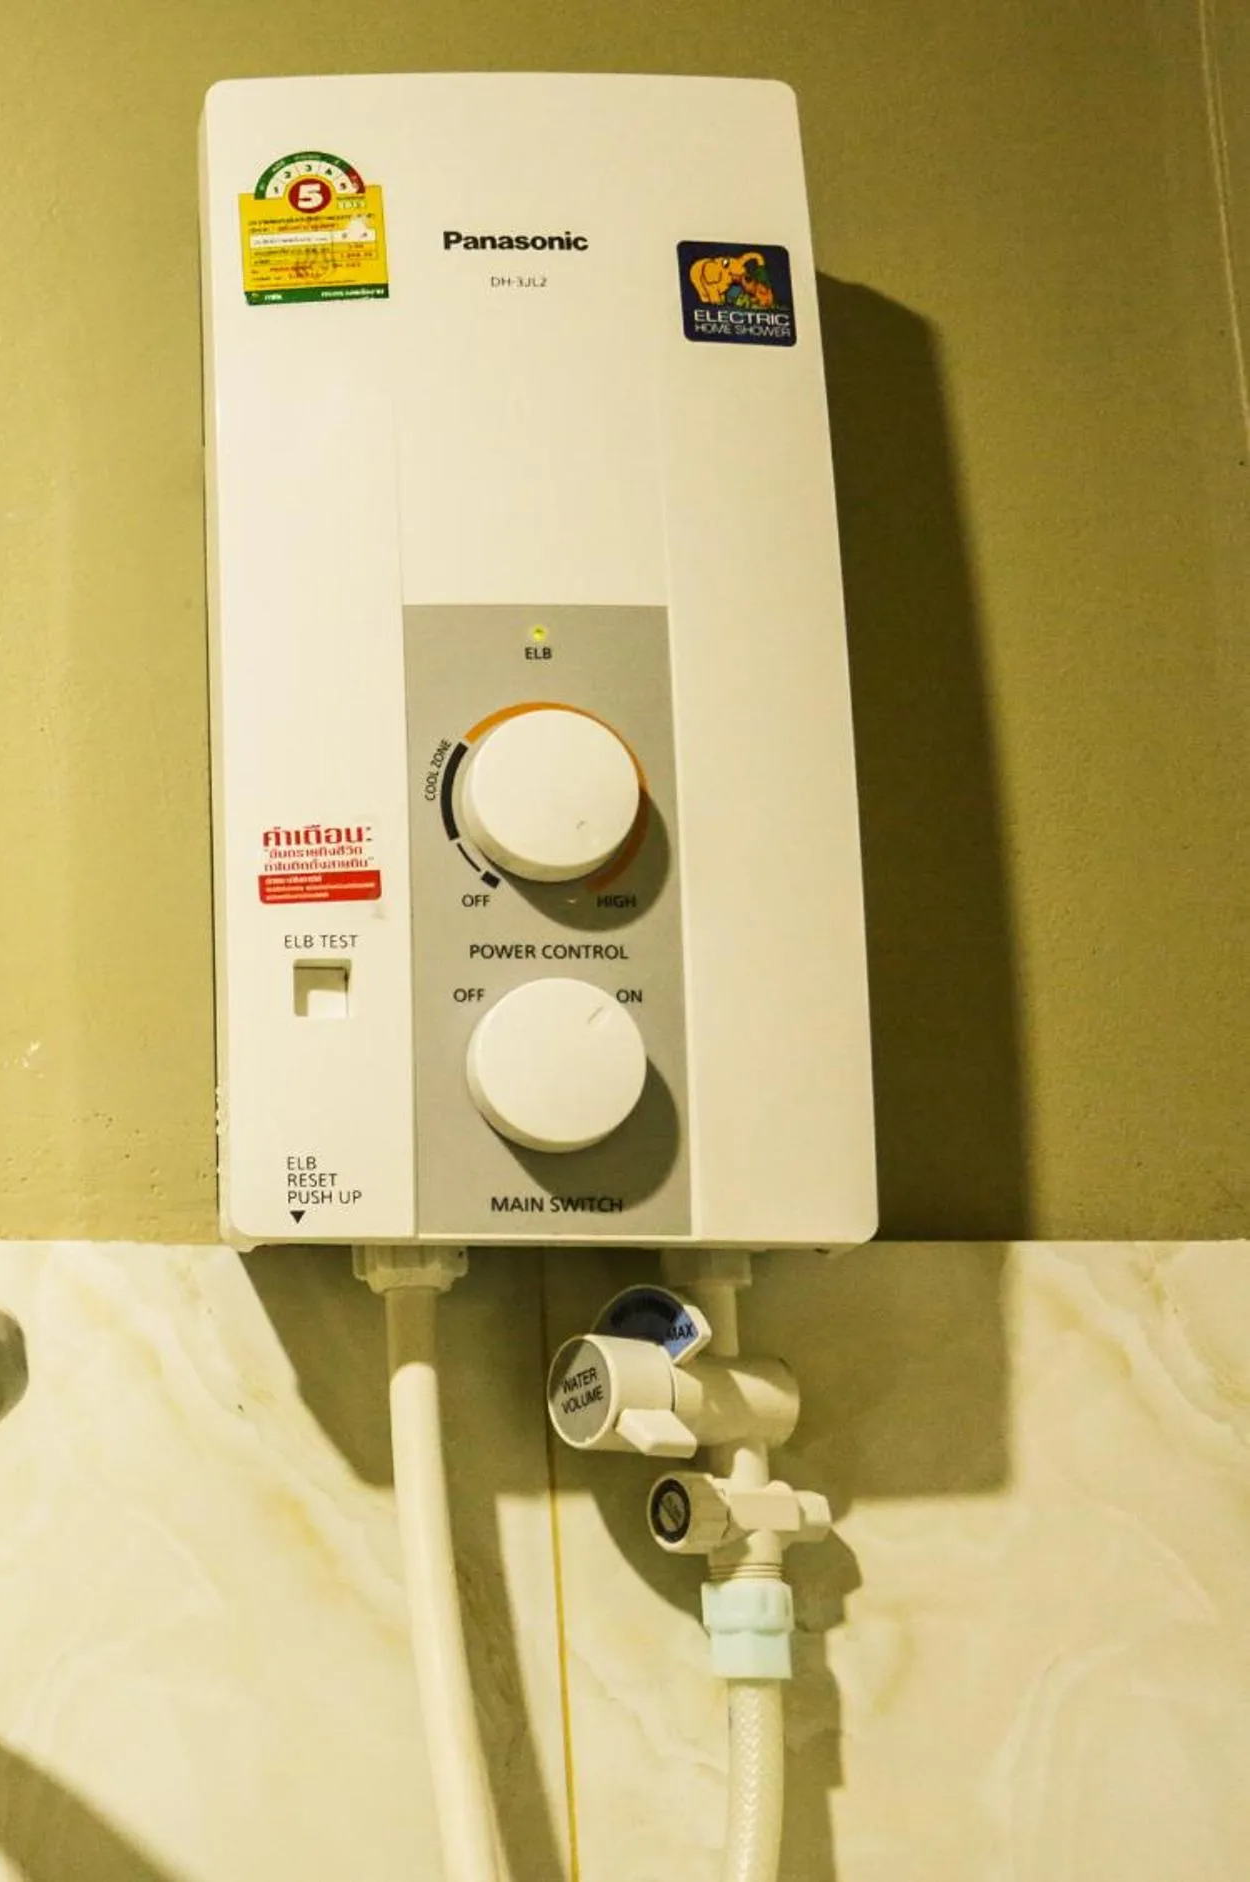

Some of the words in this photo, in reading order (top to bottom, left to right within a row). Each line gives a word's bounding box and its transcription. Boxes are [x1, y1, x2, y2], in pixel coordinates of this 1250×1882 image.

[297, 183, 324, 209] 5
[443, 231, 589, 251] Panasonic
[693, 309, 791, 326] ELECTRIC
[694, 322, 732, 335] HOME
[734, 324, 792, 338] SHOWER
[524, 646, 553, 660] ELB
[430, 738, 453, 769] ZONE
[424, 766, 440, 801] COOL
[461, 894, 491, 908] OFF
[596, 895, 637, 909] HIGH
[284, 934, 314, 949] ELB
[320, 934, 358, 949] TEST
[469, 944, 536, 960] POWER
[541, 944, 629, 960] CONTROL
[453, 988, 485, 1003] OFF
[616, 989, 643, 1004] ON
[287, 1156, 317, 1171] ELB
[287, 1173, 338, 1188] RESET
[287, 1190, 333, 1205] PUSH
[339, 1190, 362, 1205] UP
[491, 1197, 544, 1213] MAIN
[550, 1197, 623, 1213] SWITCH
[561, 1367, 599, 1394] WATER
[561, 1385, 604, 1414] VOLUME
